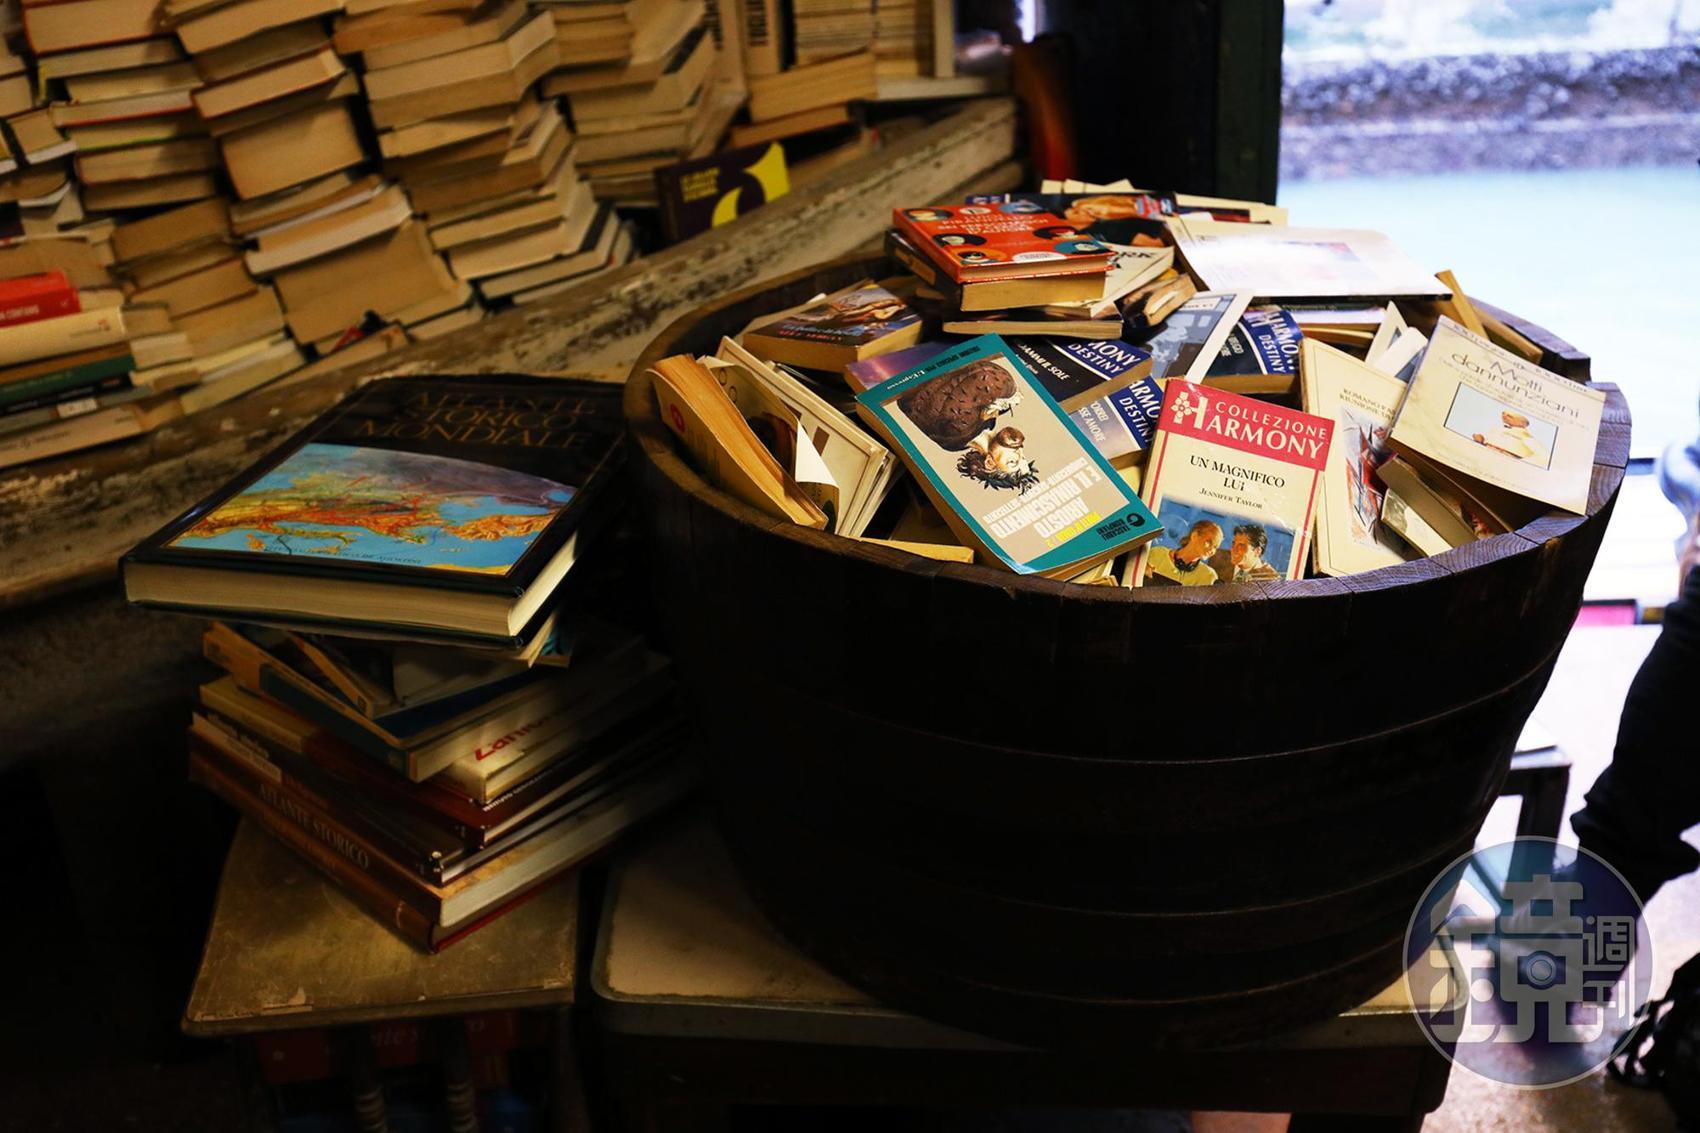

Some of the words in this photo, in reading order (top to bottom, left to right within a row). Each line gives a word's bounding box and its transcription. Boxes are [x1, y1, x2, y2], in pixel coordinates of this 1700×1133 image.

[1067, 343, 1124, 374] DESTINY
[1087, 341, 1141, 366] MONY
[1258, 334, 1286, 373] DESTINY
[1048, 366, 1070, 381] SOLE
[1129, 379, 1160, 423] ARMO
[1216, 401, 1327, 439] COLLEZIONE
[1171, 391, 1324, 459] HARMONY
[1085, 463, 1101, 482] E
[1190, 455, 1208, 469] UN
[1212, 461, 1285, 488] MAGNIFICO
[989, 476, 1080, 540] RINASCIMENTO
[1033, 496, 1088, 539] ARIOSTO
